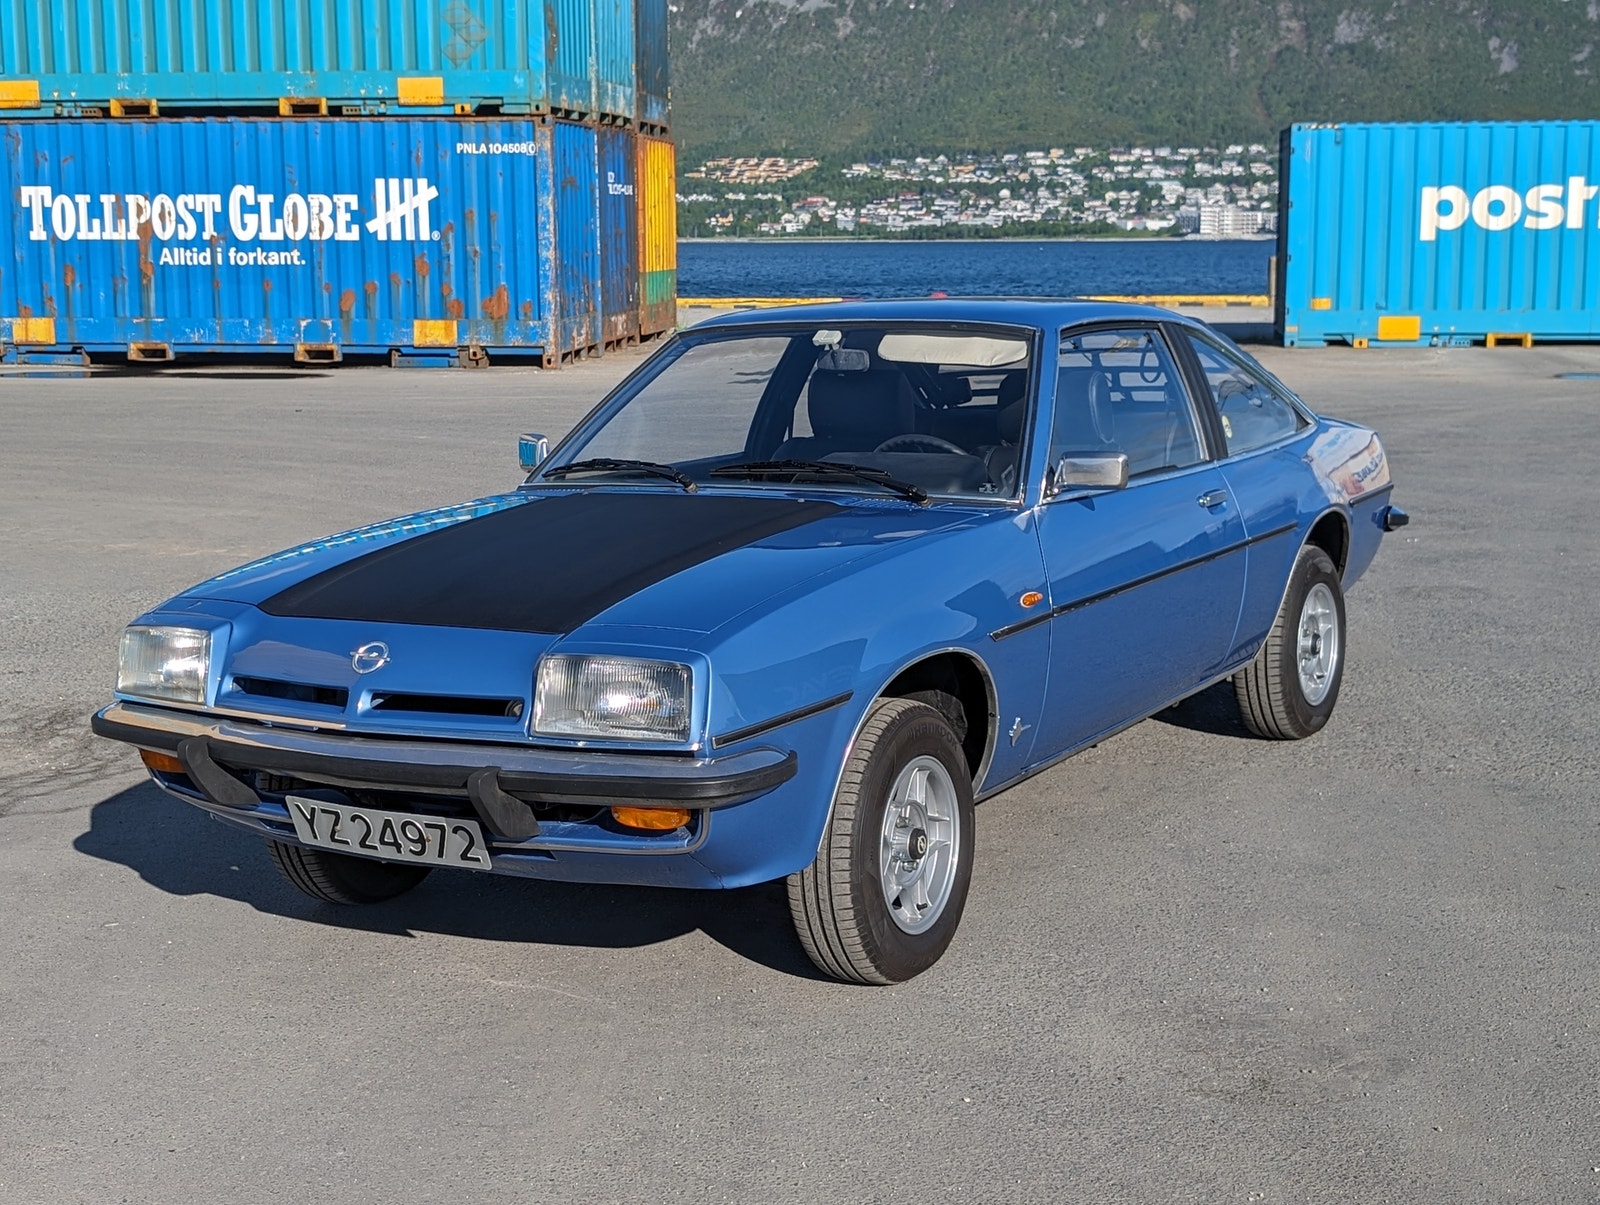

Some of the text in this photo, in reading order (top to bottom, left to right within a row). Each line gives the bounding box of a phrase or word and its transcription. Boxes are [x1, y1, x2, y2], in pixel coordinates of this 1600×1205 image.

[456, 142, 487, 154] PNLA
[20, 184, 359, 242] TOLLPOST GLOBE
[1419, 175, 1600, 241] post
[159, 247, 307, 266] Alltid i forkant.
